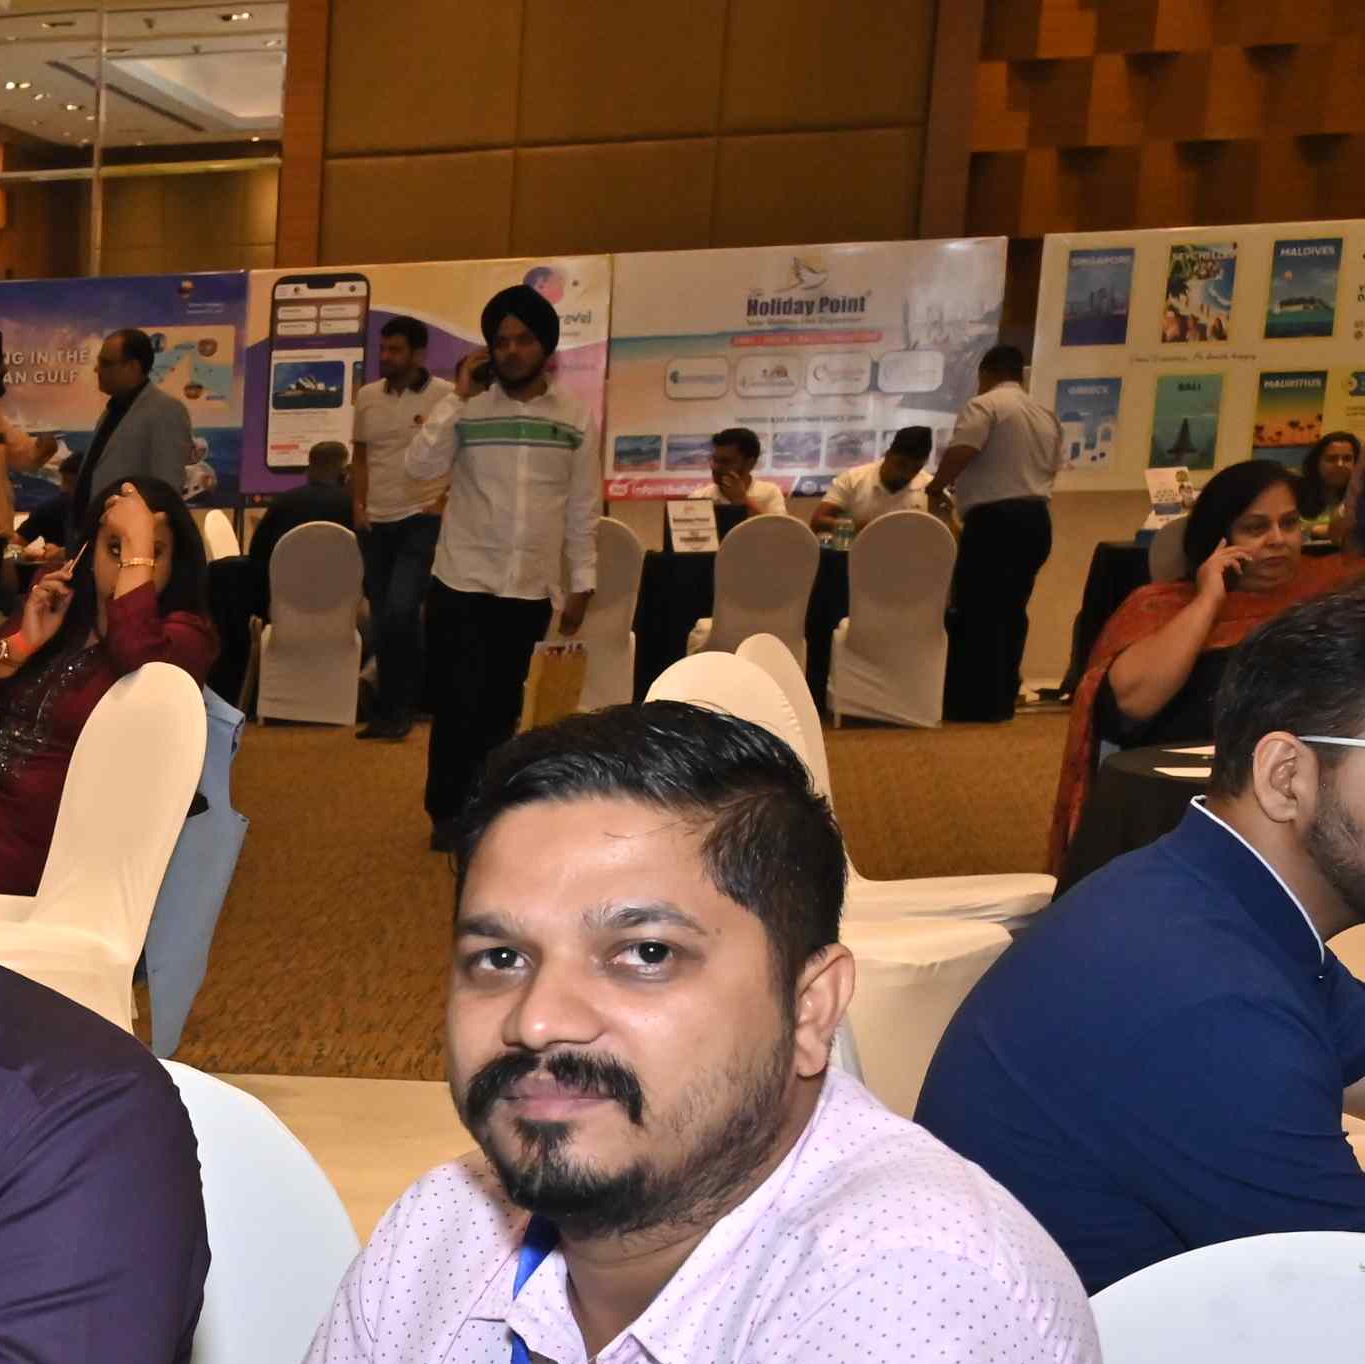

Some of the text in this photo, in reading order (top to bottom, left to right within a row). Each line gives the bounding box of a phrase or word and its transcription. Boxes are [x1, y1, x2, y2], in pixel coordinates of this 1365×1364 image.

[1279, 246, 1336, 257] MALDIVES
[746, 295, 866, 317] Holiday Point
[49, 350, 87, 365] THE
[33, 371, 78, 385] GULF
[1263, 378, 1322, 389] MAURITIUS
